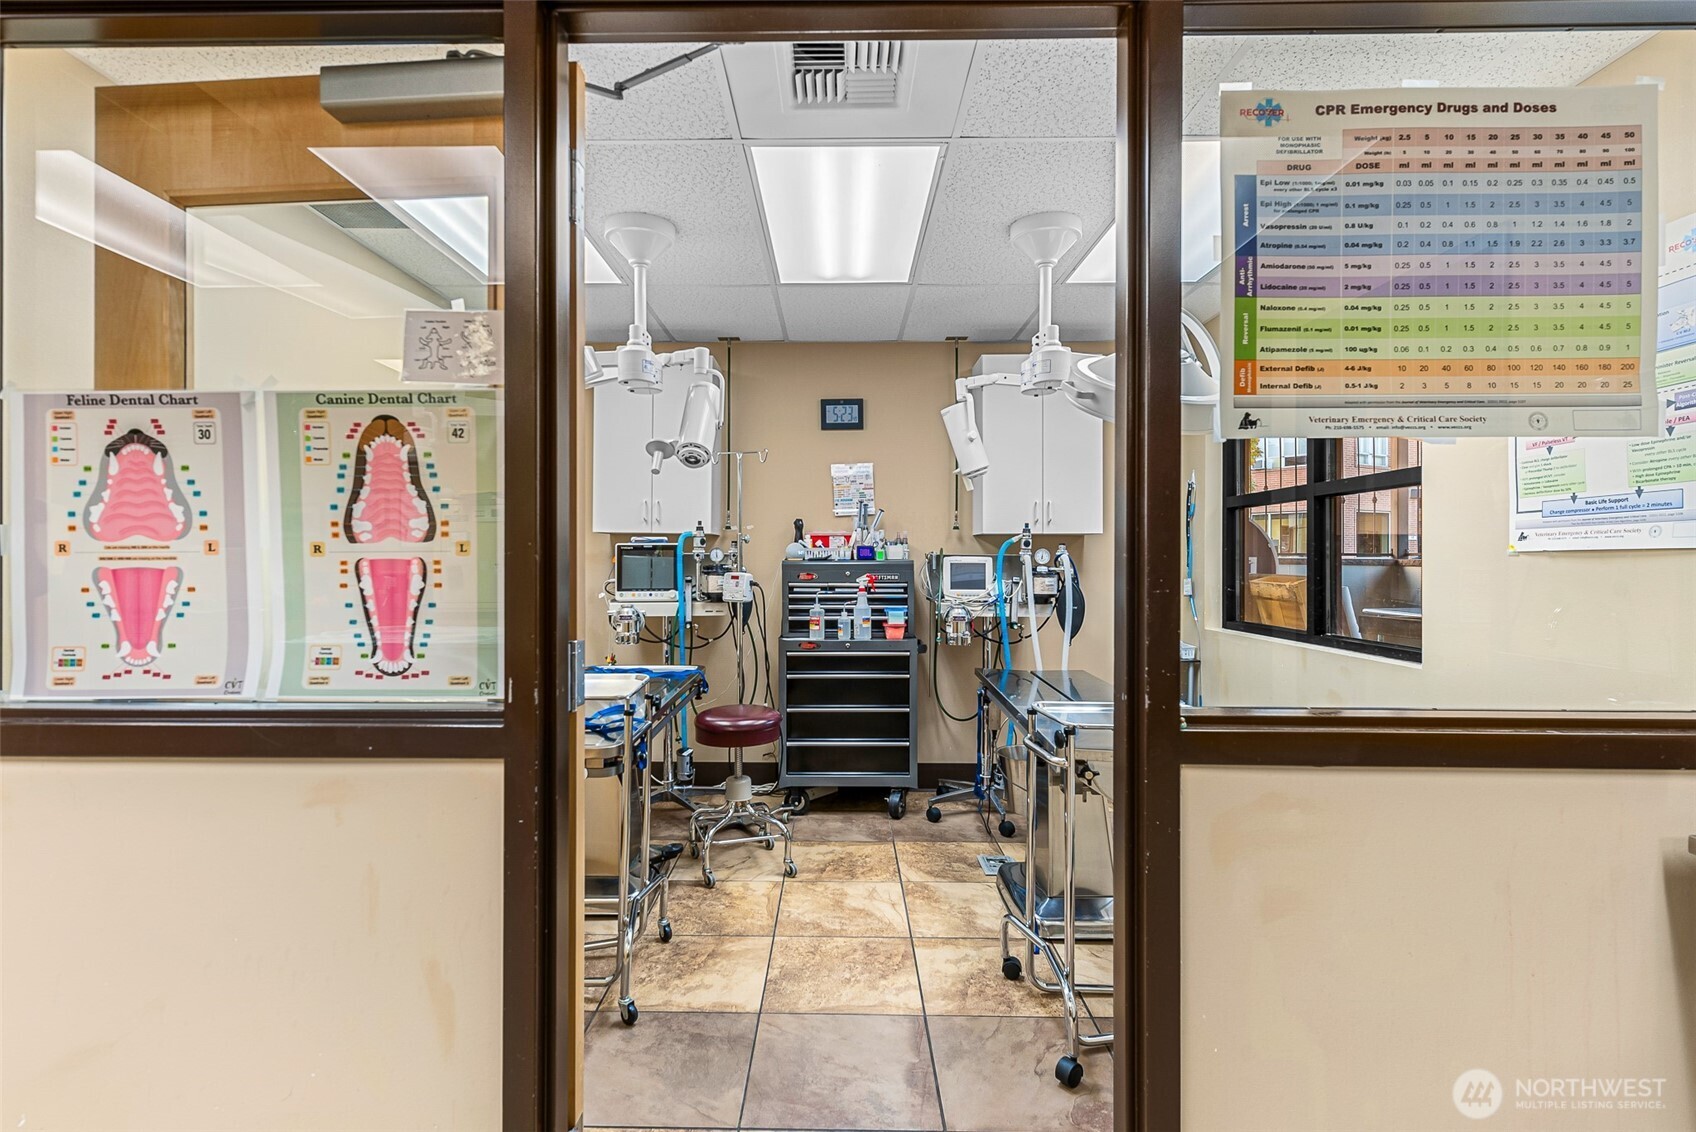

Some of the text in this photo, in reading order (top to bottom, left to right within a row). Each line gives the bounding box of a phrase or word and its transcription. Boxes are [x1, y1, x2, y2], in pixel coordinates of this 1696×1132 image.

[1316, 102, 1557, 116] CPR Emergency Drugs and Doses
[66, 394, 198, 406] Feline Dental Chart
[315, 392, 457, 405] Canine Dental Chart
[1352, 416, 1394, 424] Emergency
[1460, 415, 1487, 424] Society
[1678, 415, 1690, 423] PEA
[198, 429, 211, 440] 30
[452, 428, 464, 439] 42
[58, 544, 67, 553] R
[208, 543, 216, 552] L
[313, 544, 322, 554] R
[459, 544, 468, 552] L
